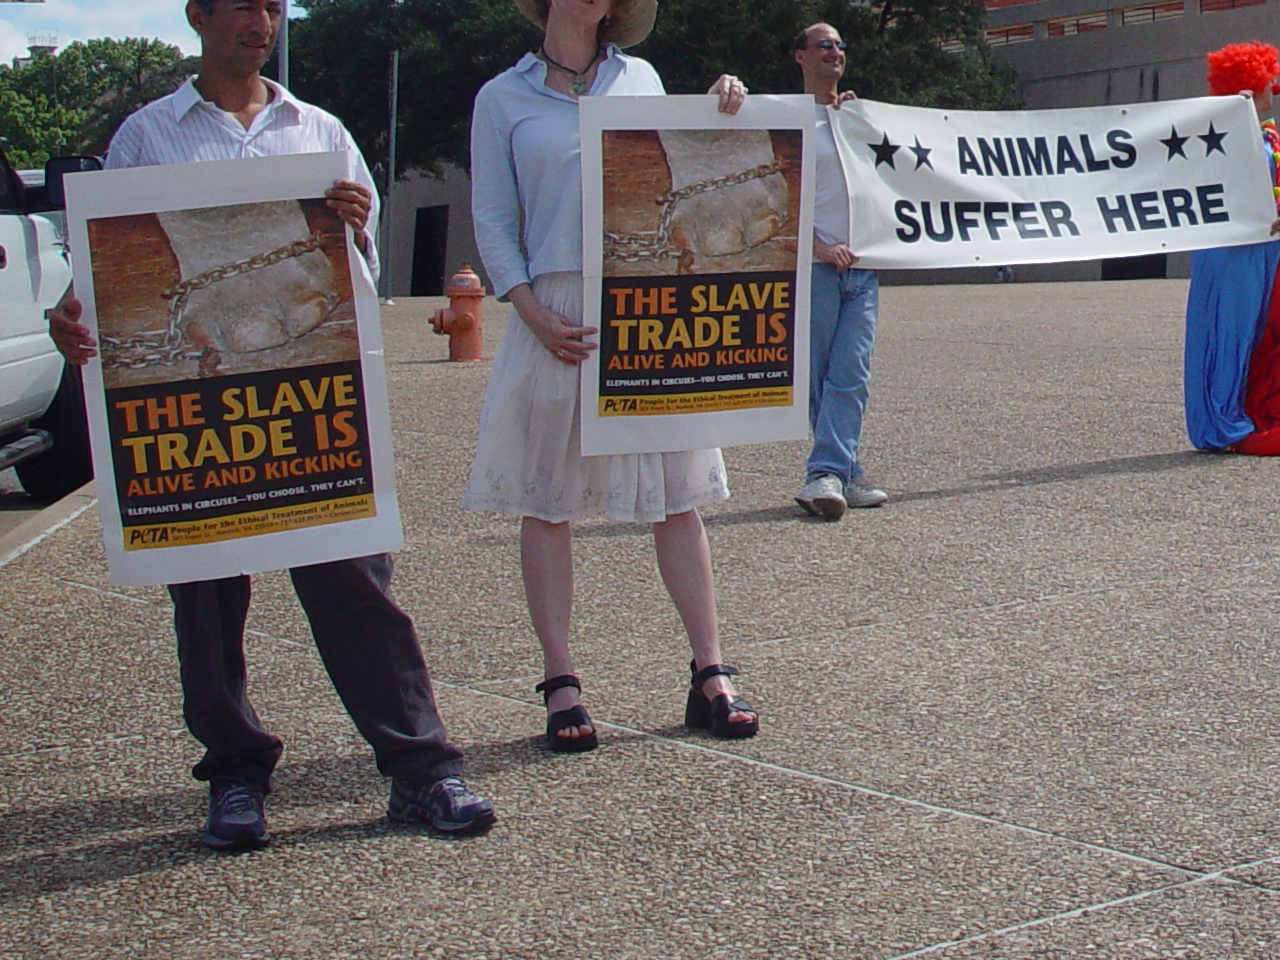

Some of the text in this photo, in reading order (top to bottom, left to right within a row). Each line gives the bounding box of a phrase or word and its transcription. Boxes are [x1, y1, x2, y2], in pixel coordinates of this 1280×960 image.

[956, 129, 1137, 176] ANIMALS
[895, 183, 1229, 243] SUFFER HERE
[610, 282, 790, 316] THE SLAVE
[610, 312, 787, 351] TRADE IS
[608, 347, 788, 370] ALIVE AND KICKING
[605, 379, 650, 387] ELEPHANTS
[651, 378, 660, 386] IN
[747, 371, 765, 379] THEY
[115, 374, 357, 433] THE SLAVE
[122, 411, 358, 474] TRADE IS
[126, 451, 362, 497] ALIVE AND KICKING
[128, 503, 180, 516] ELEPHANTS
[182, 502, 192, 511] IN
[268, 486, 308, 498] CHOOSE.
[310, 481, 334, 492] THEY
[171, 525, 201, 535] People
[203, 522, 217, 530] for
[220, 520, 235, 528] the
[238, 514, 269, 525] Ethical
[272, 507, 318, 520] Treatment
[321, 503, 330, 512] of
[333, 499, 368, 511] Animals
